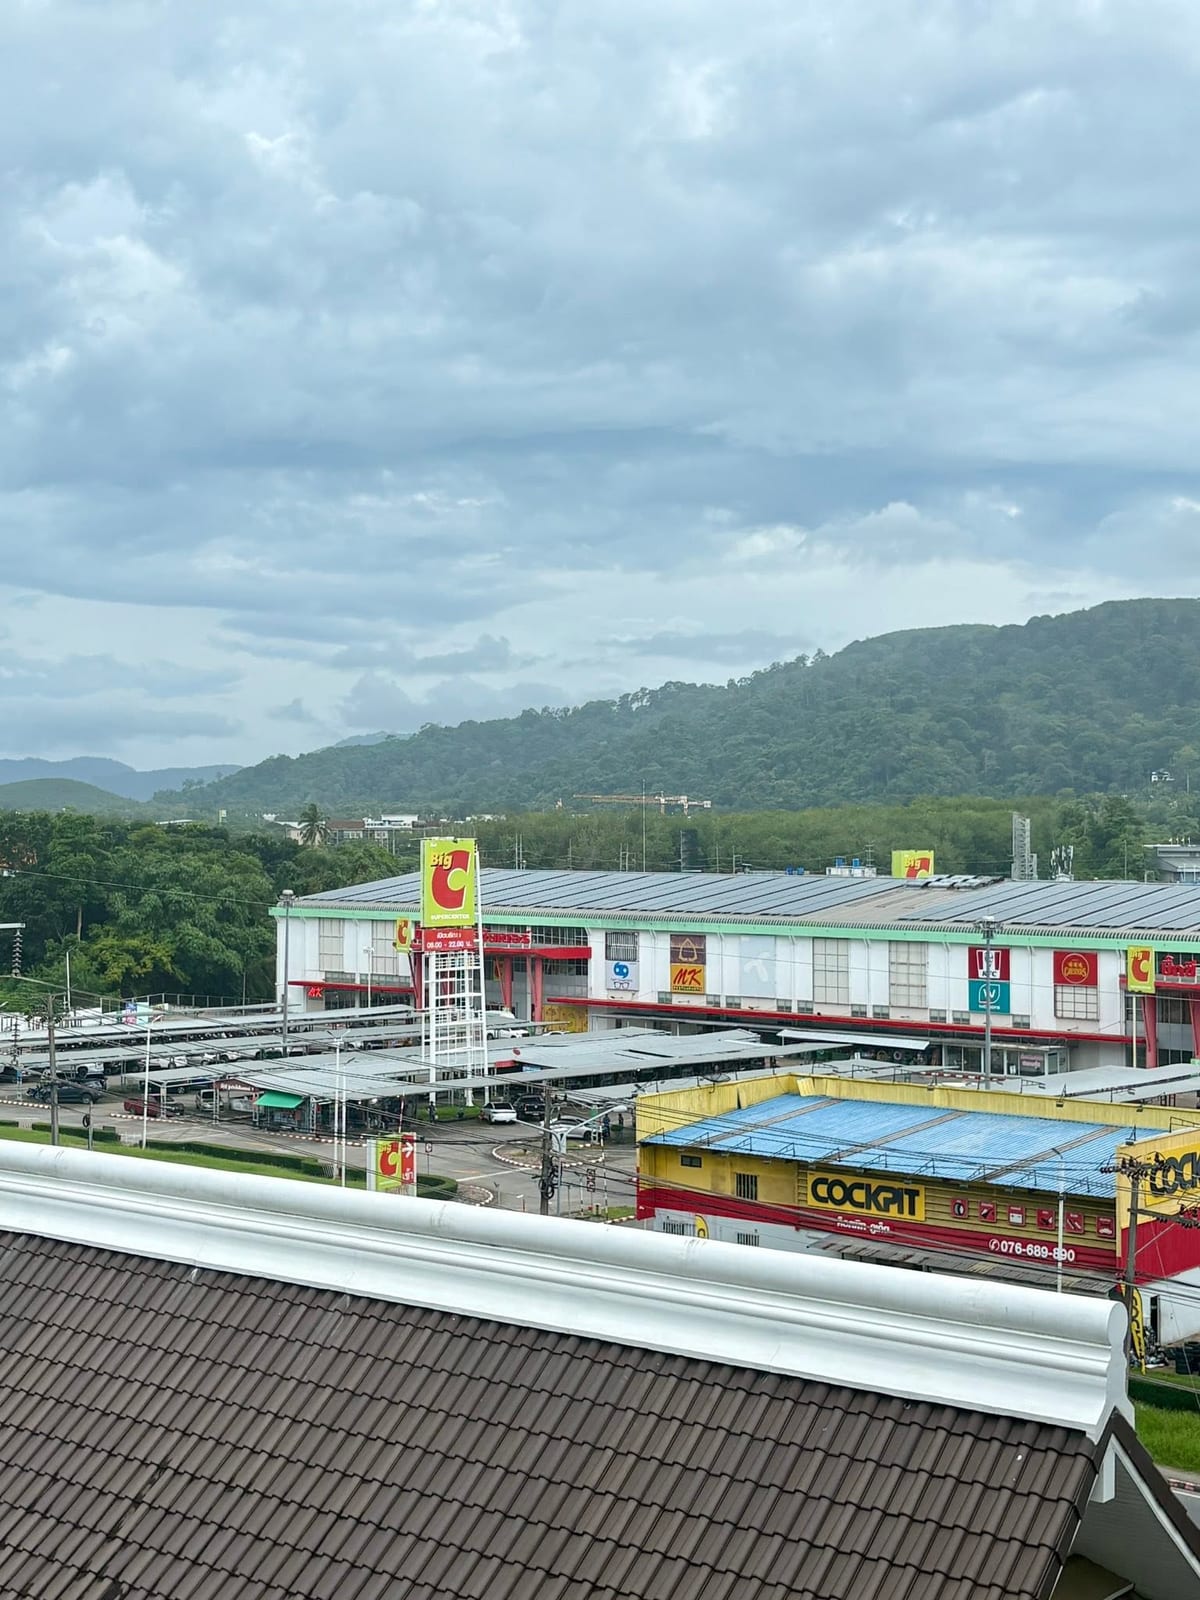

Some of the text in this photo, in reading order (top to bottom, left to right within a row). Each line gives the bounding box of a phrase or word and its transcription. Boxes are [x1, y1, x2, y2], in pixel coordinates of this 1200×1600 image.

[431, 849, 471, 910] Big C
[673, 968, 702, 986] MK
[1131, 949, 1151, 984] C
[378, 1140, 399, 1177] C
[811, 1177, 920, 1216] COCKPIT
[1000, 1240, 1076, 1262] 076-689-890
